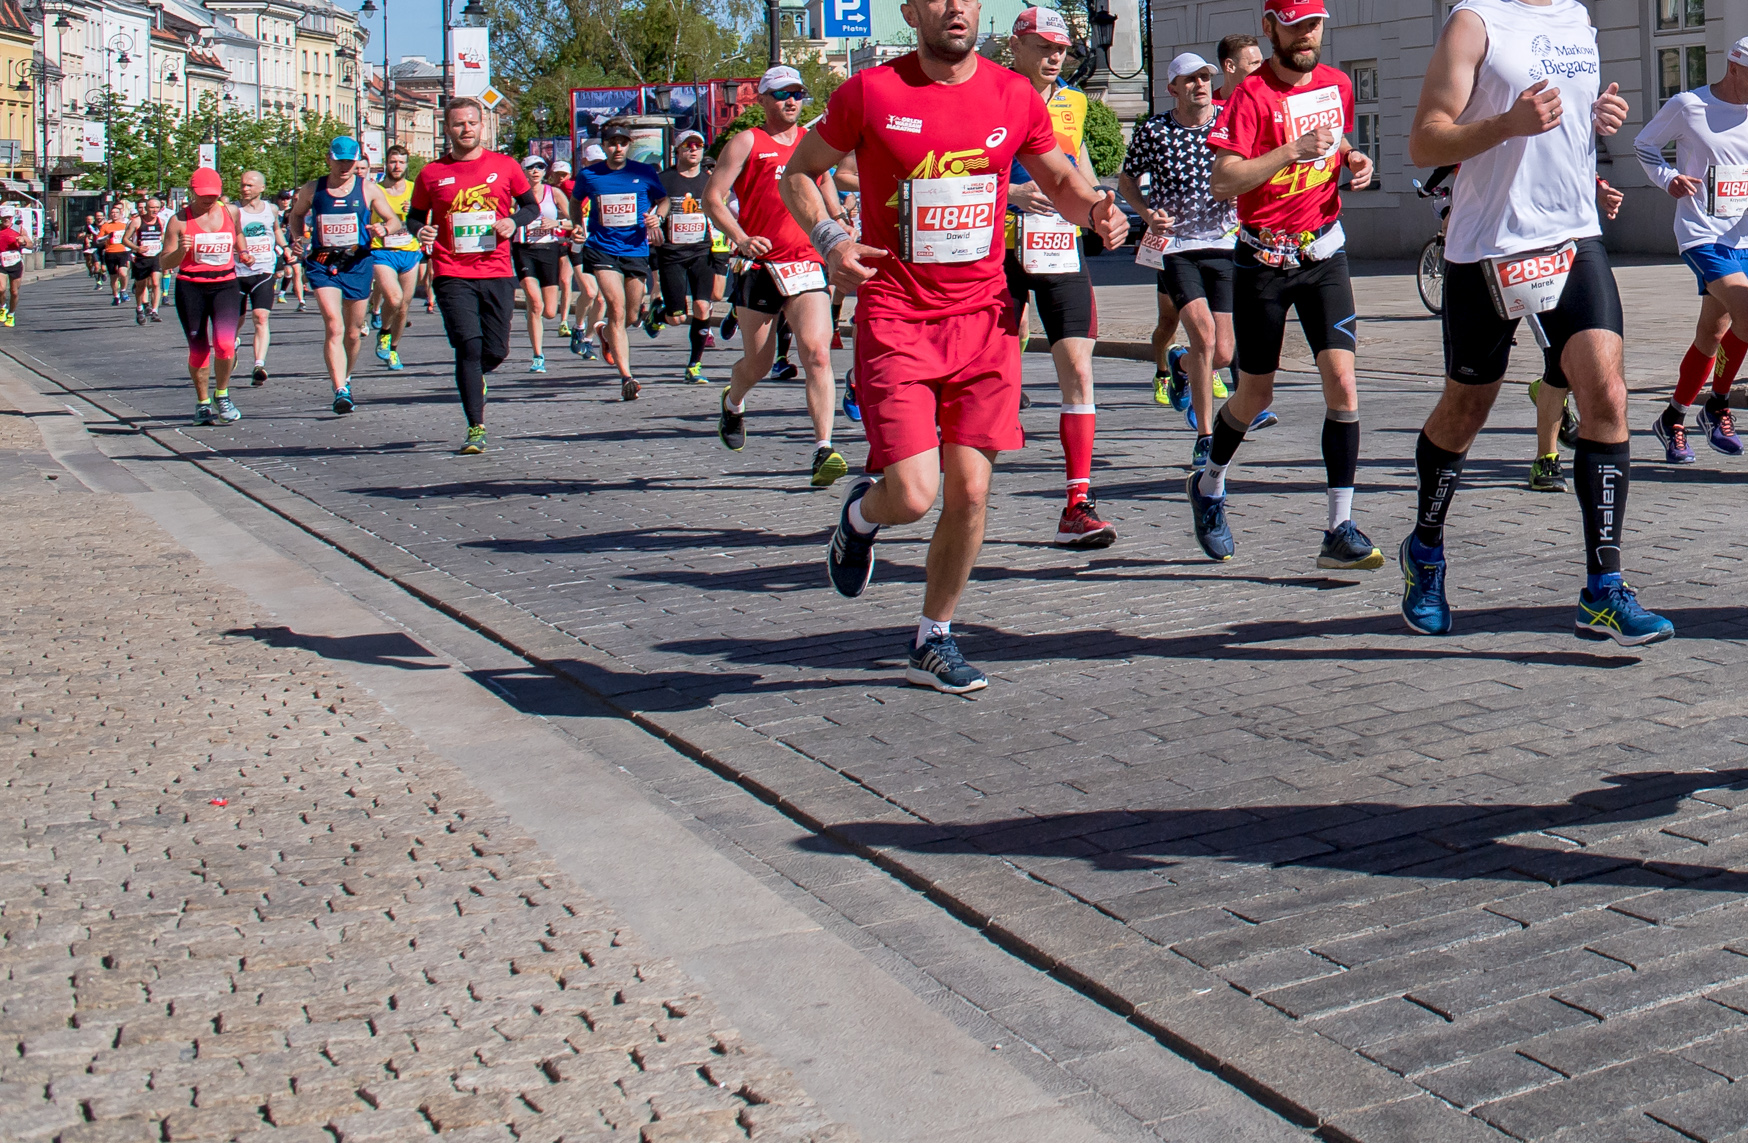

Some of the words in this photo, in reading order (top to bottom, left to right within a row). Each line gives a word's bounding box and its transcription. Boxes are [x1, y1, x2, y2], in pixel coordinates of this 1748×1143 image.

[1554, 44, 1595, 56] Markowi
[1540, 58, 1597, 79] Biegacze
[1299, 109, 1339, 138] 2282
[606, 204, 633, 214] 5034
[924, 204, 990, 230] 4842
[326, 224, 354, 234] 3098
[676, 223, 702, 232] 3366
[946, 232, 970, 240] Dawid
[1032, 232, 1070, 249] 5588
[1142, 233, 1164, 250] 2223
[198, 244, 229, 254] 4768
[247, 244, 269, 253] 2252
[1506, 252, 1570, 284] 2854
[1531, 278, 1554, 290] Marek
